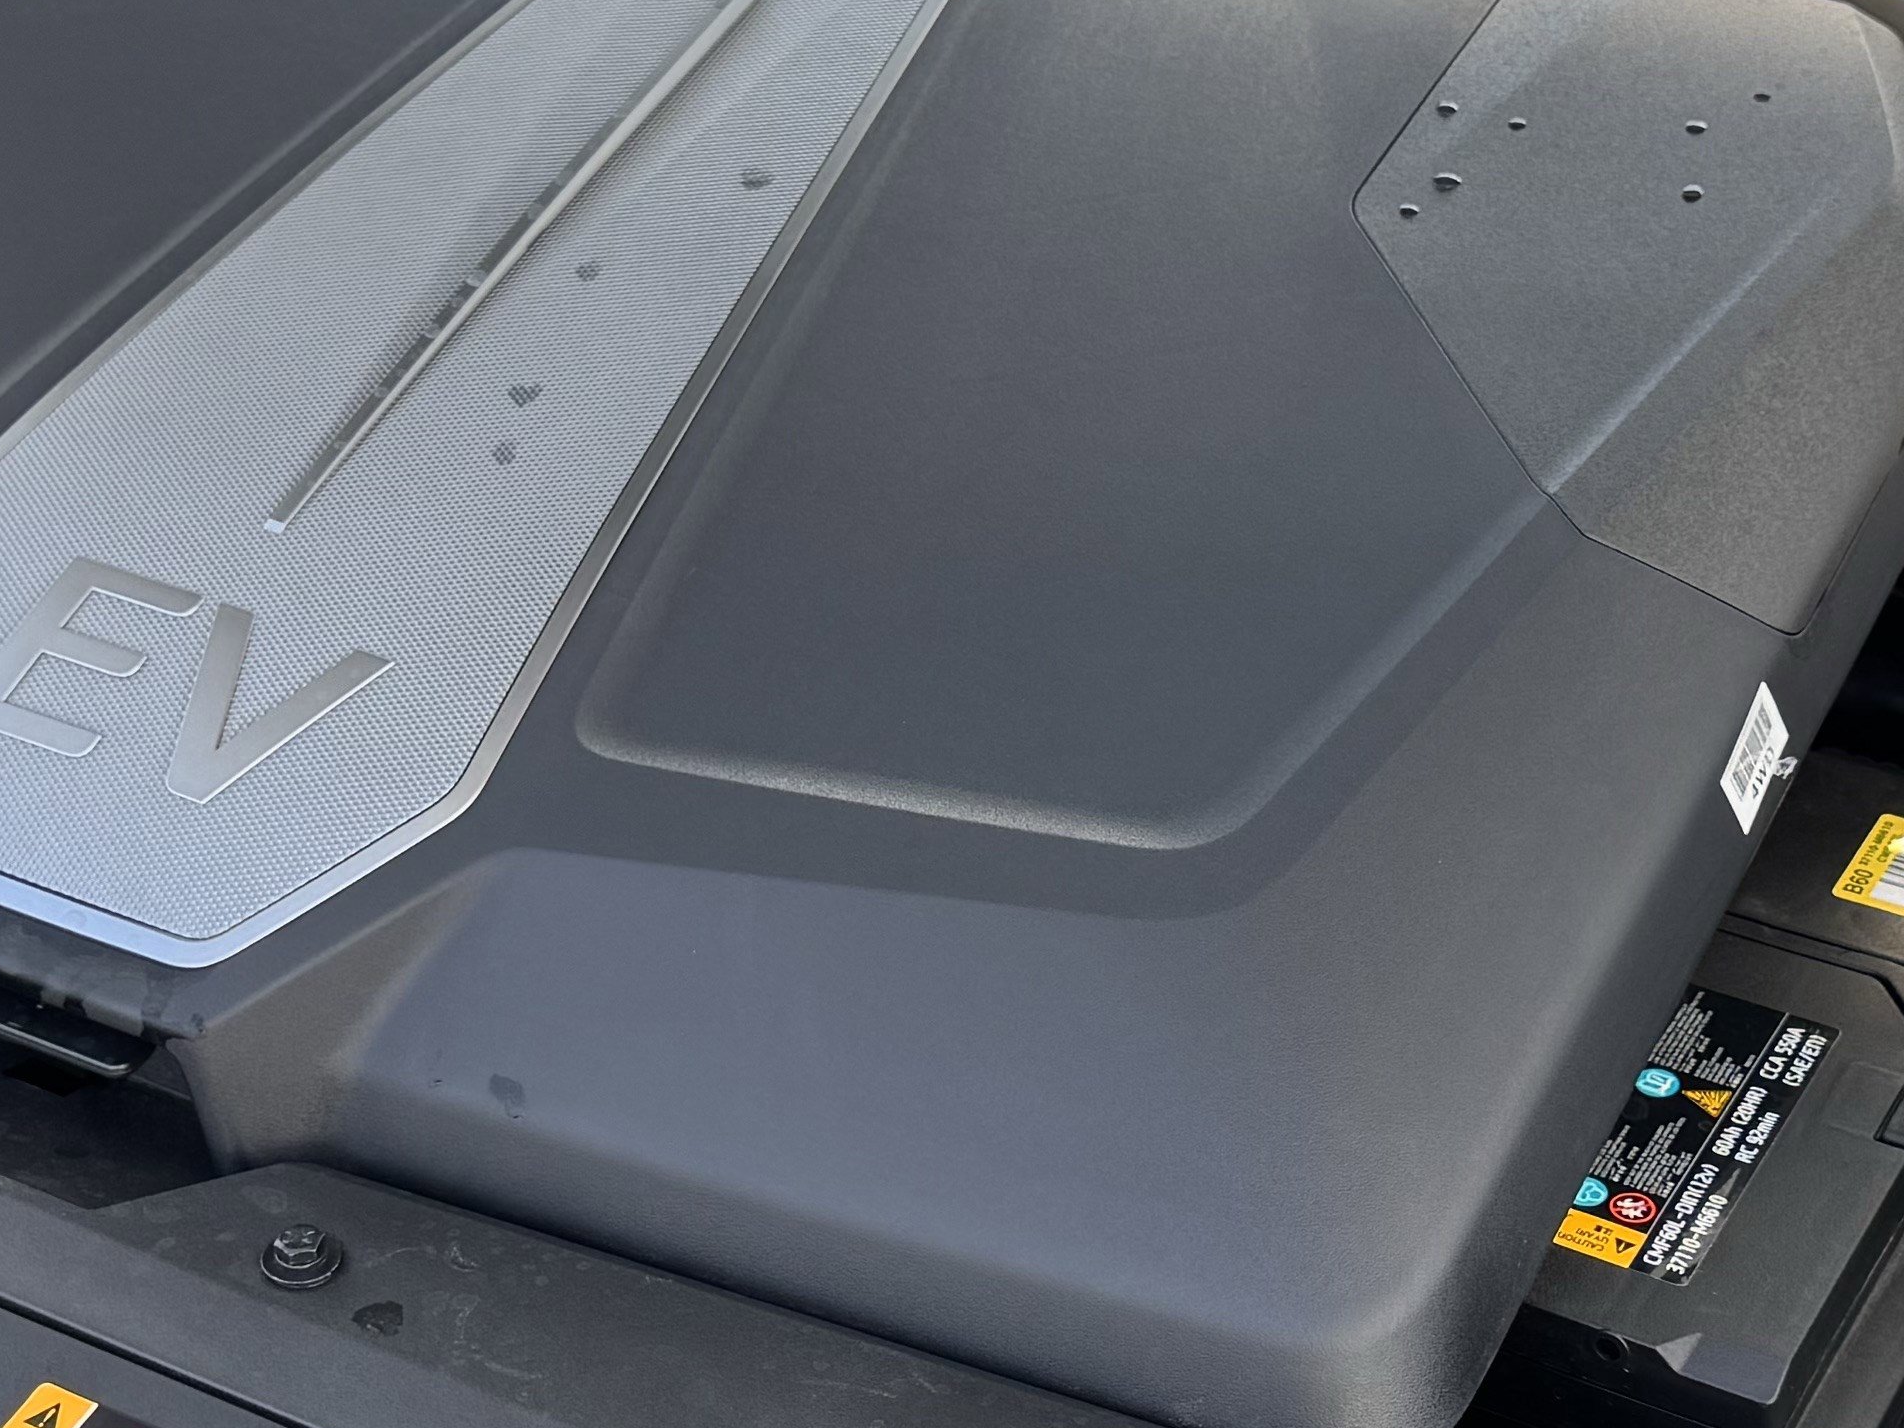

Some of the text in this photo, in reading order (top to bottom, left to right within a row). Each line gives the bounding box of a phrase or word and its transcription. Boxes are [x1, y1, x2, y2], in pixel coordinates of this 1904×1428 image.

[1842, 868, 1873, 895] B60
[1759, 1027, 1806, 1080] CCA 550A
[1711, 1126, 1744, 1158] 60Ah
[1731, 1086, 1769, 1126] (20HR)
[1734, 1111, 1781, 1164] RC 92min
[1665, 1194, 1728, 1275] 37110-M6610
